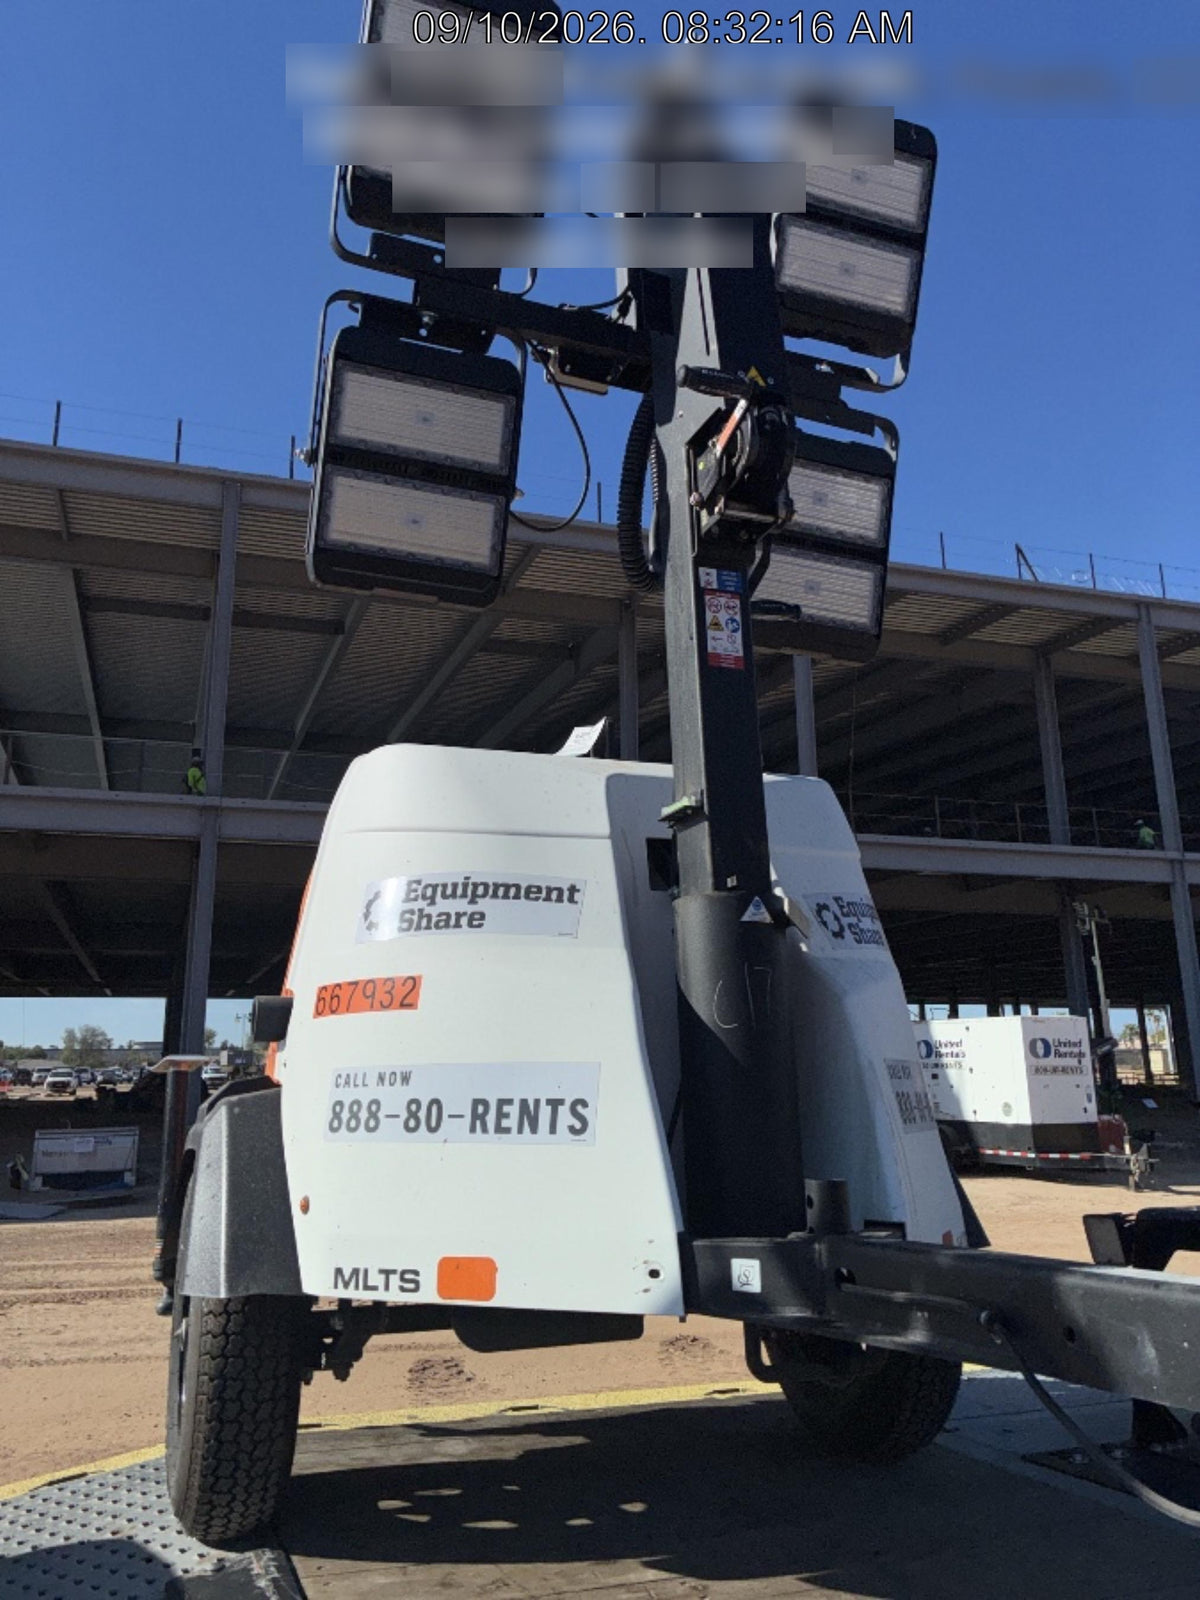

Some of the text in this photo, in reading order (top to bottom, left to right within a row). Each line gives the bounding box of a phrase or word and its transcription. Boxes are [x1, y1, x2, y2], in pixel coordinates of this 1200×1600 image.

[402, 874, 581, 905] Equipment
[397, 909, 487, 933] Share
[315, 975, 418, 1017] 667932
[1052, 1038, 1082, 1048] United
[334, 1070, 412, 1089] CALL NOW
[328, 1098, 590, 1136] 888-80-RENTS
[333, 1267, 421, 1293] MLTS
